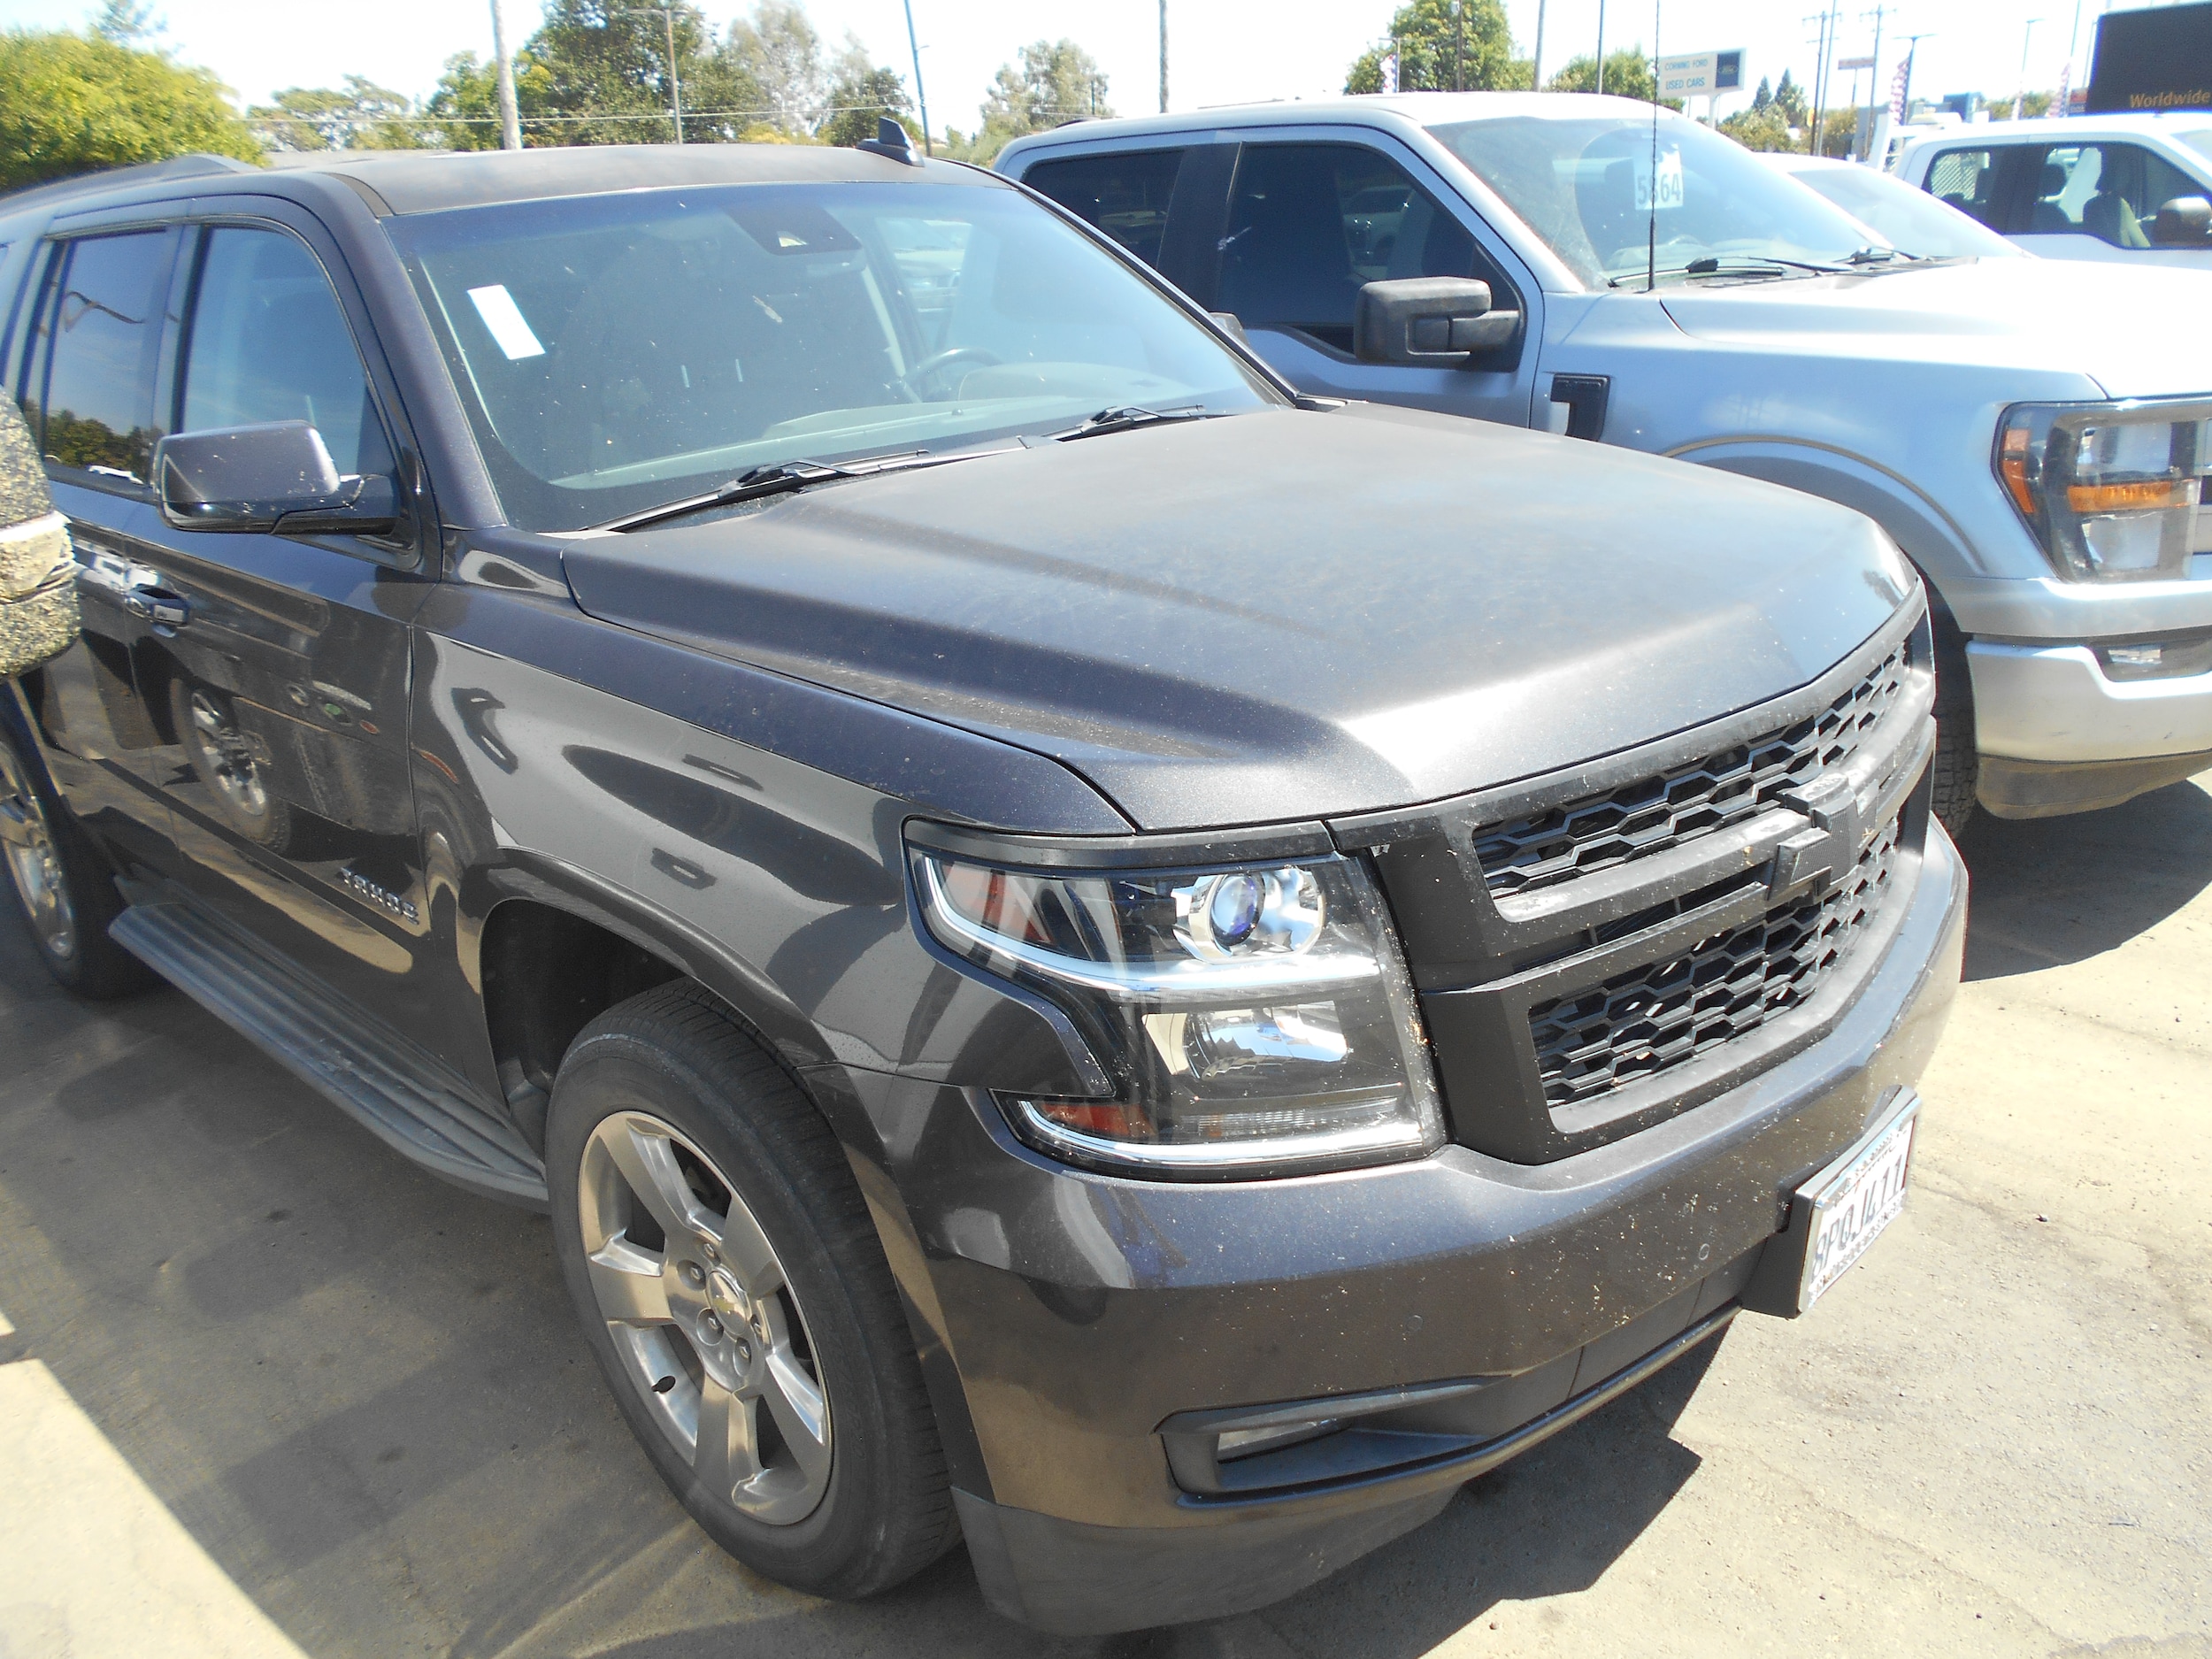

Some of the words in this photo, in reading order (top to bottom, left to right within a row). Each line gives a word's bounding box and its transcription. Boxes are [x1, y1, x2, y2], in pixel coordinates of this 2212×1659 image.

[1693, 58, 1708, 68] FORD
[1666, 80, 1684, 90] USED
[1686, 77, 1705, 88] CARS
[2130, 89, 2211, 108] Worldwide
[1637, 173, 1681, 204] 5864
[340, 866, 419, 926] TAHOE
